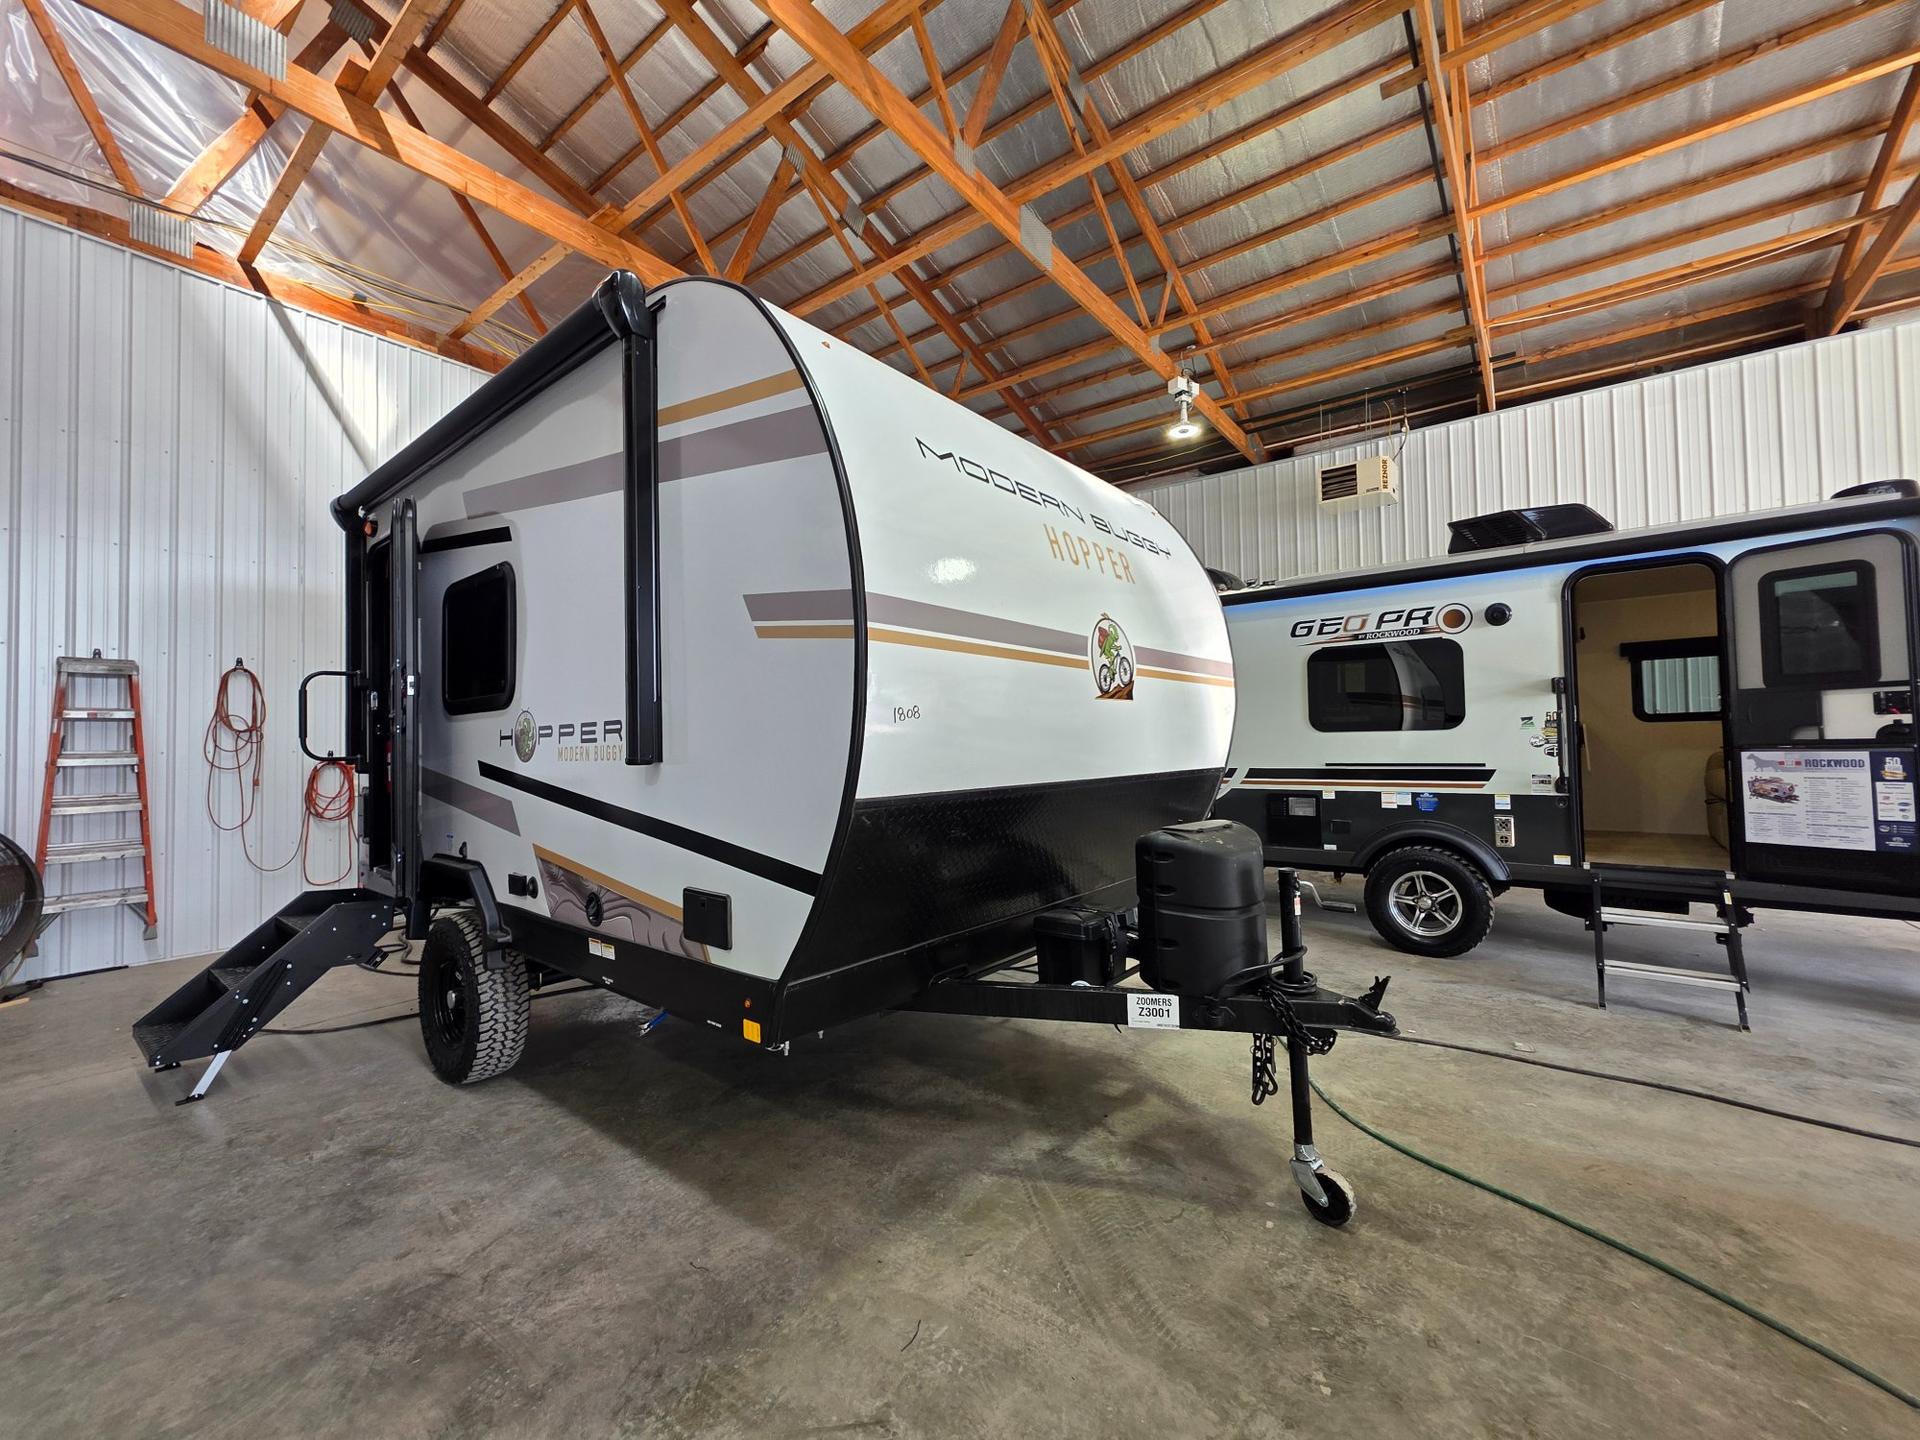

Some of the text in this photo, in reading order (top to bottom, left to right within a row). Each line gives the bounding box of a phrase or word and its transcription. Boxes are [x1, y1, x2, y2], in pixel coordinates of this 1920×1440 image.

[915, 437, 1172, 558] MODERN BUGGY
[1043, 523, 1136, 584] HOPPER
[1290, 602, 1474, 638] GEO PRO
[1366, 628, 1421, 640] ROCKWOOD
[893, 705, 921, 724] 1808
[557, 744, 623, 762] MODERN BUGGY
[1804, 758, 1865, 768] ROCKWOOD
[1136, 997, 1172, 1007] ZOOMERS
[1138, 1007, 1170, 1018] Z3001
